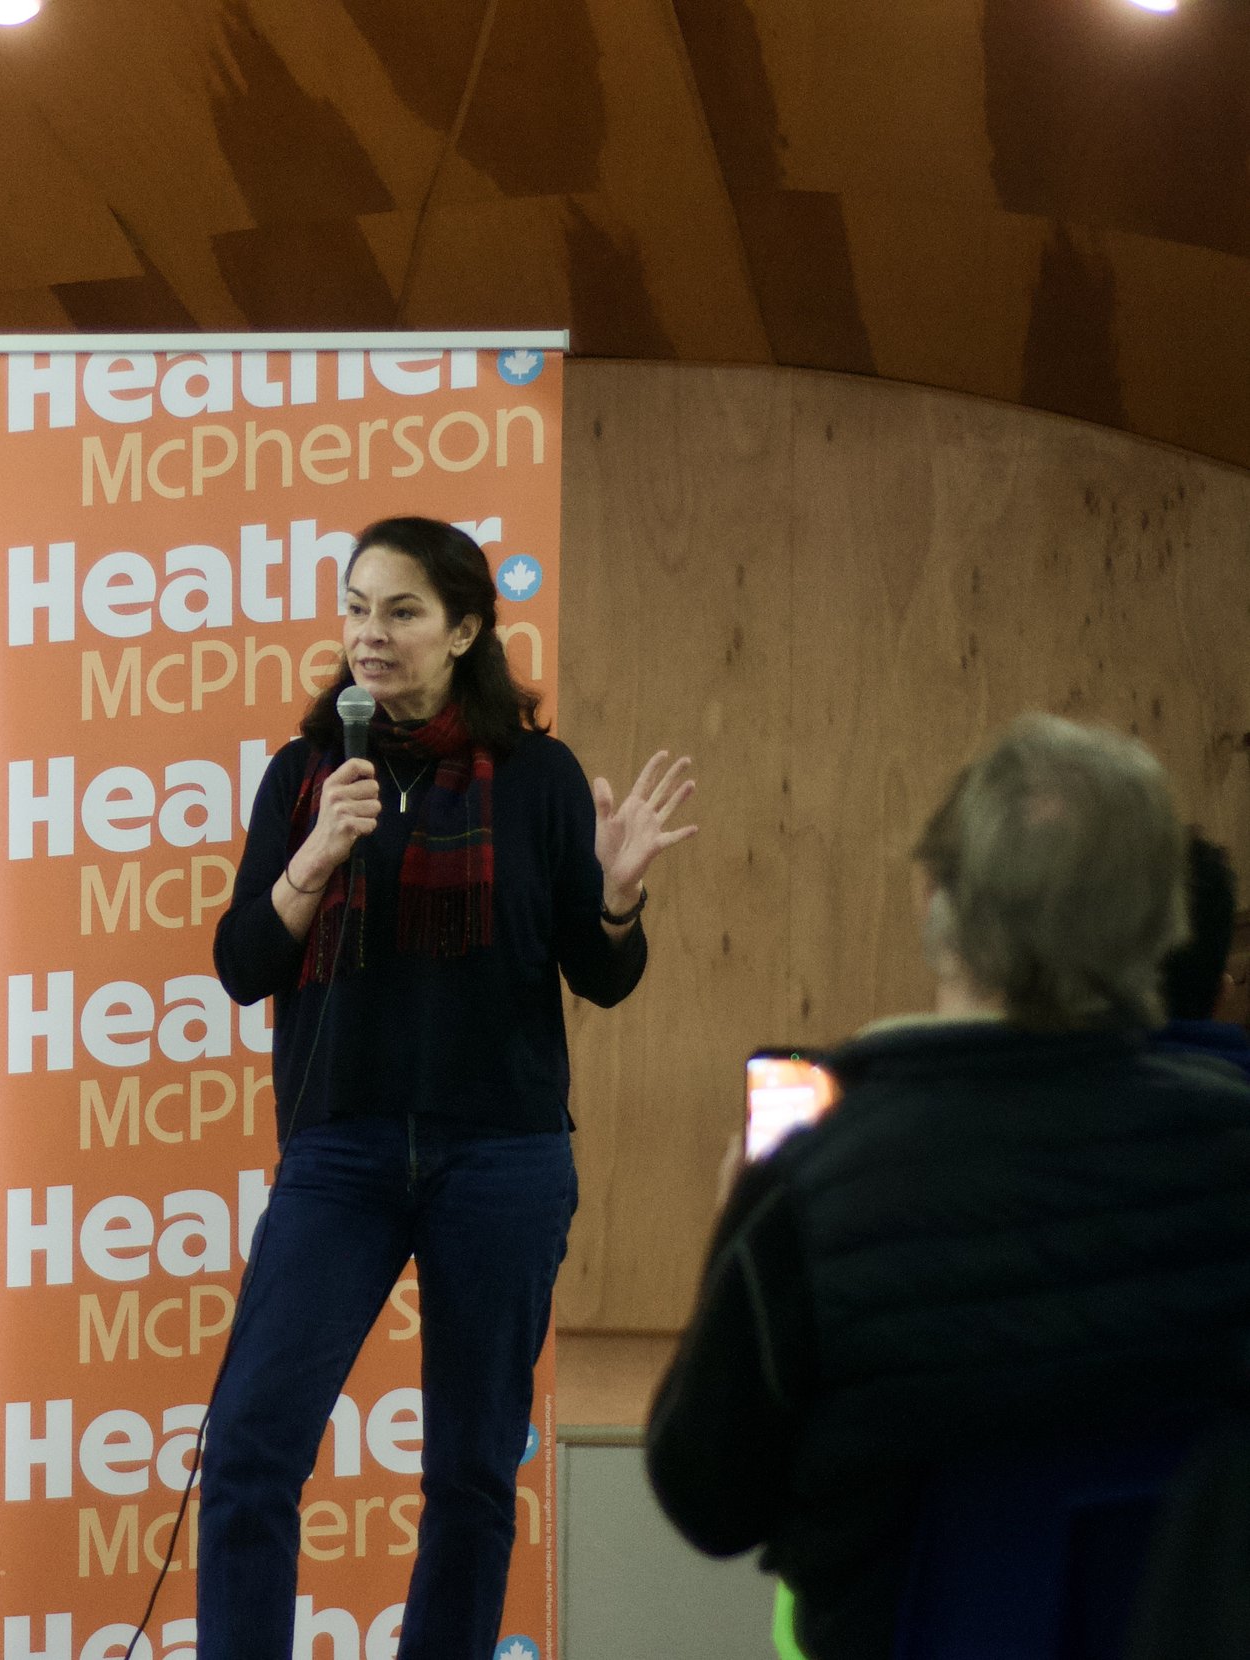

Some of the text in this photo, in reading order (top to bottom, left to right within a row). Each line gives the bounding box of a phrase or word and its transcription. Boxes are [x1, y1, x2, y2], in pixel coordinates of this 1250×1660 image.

[82, 405, 545, 507] McPherson
[8, 516, 502, 646] Heath
[81, 621, 543, 720] McPhen
[8, 736, 303, 860] Heat
[6, 1168, 272, 1288] Heat
